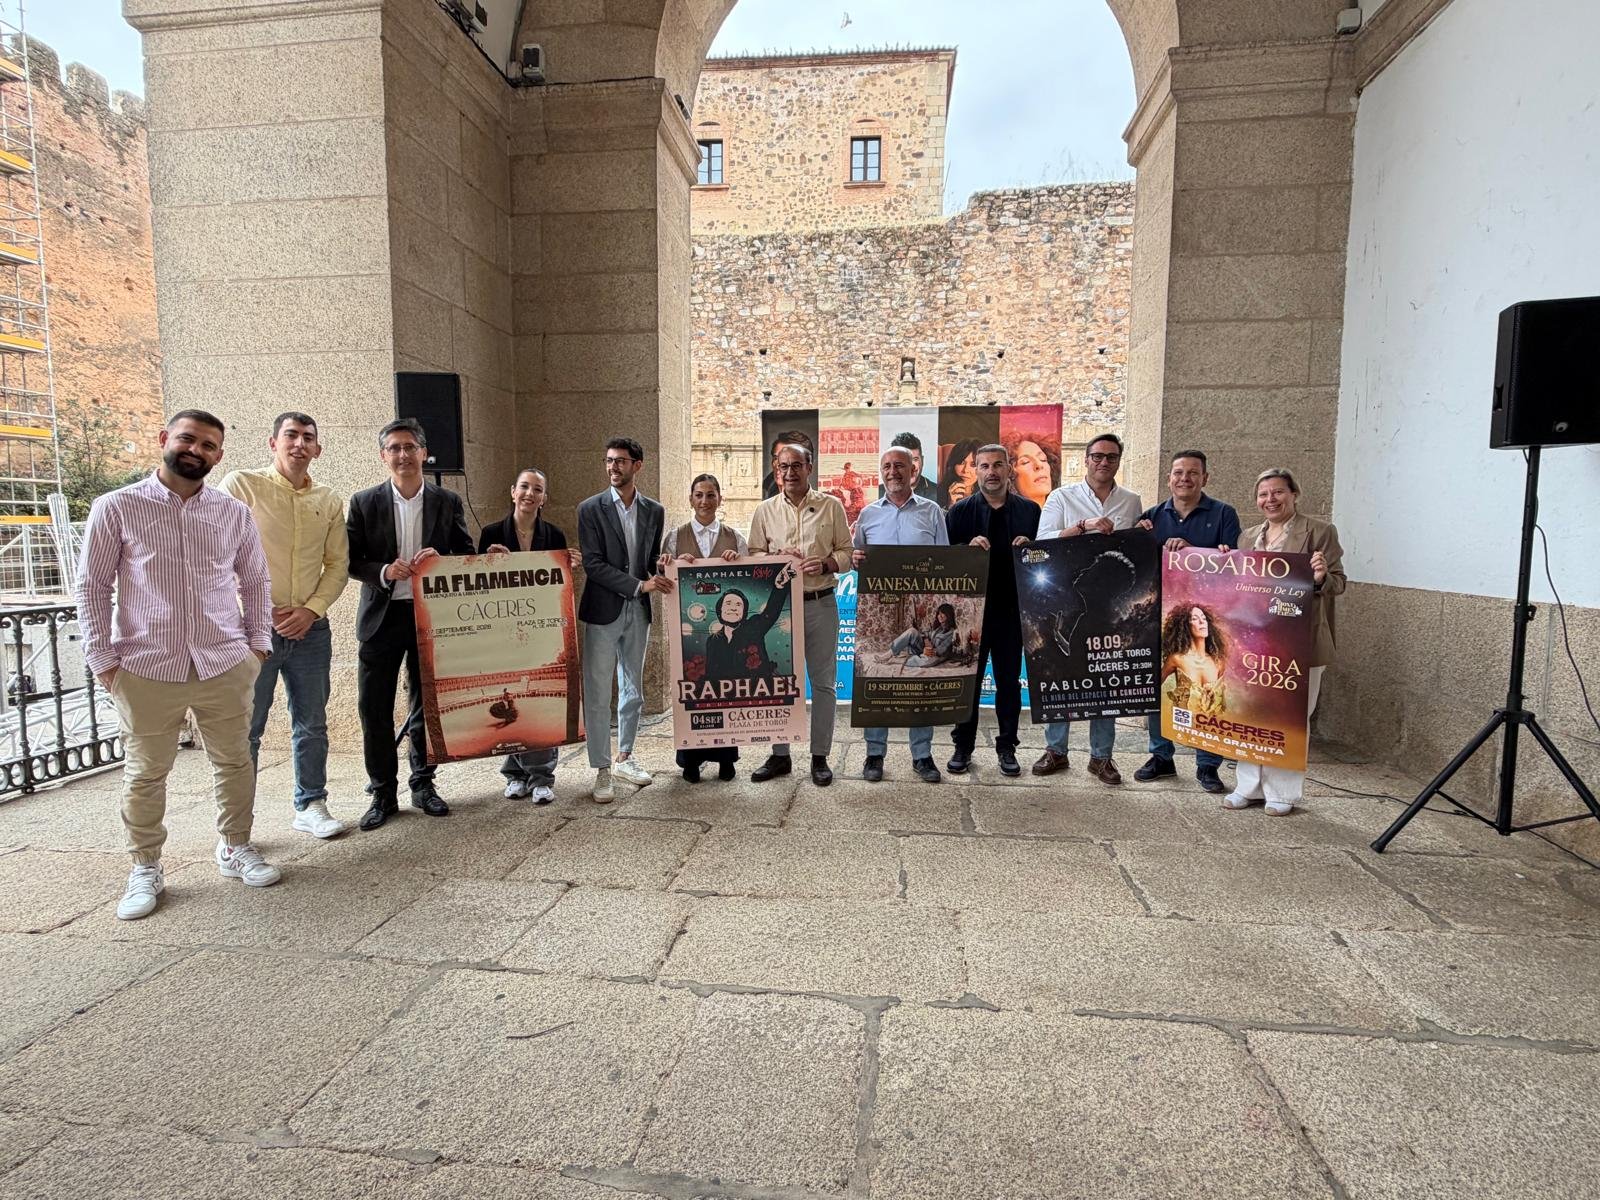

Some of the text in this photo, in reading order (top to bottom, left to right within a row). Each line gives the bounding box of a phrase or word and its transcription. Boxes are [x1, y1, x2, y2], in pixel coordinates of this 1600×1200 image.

[1168, 551, 1290, 579] ROSARIO
[422, 568, 564, 594] LA FLAMENCA
[696, 570, 751, 579] RAPHAEL
[866, 577, 920, 591] VANESA
[923, 573, 978, 591] MARTÍN
[1235, 582, 1305, 598] Universo De Ley
[457, 598, 536, 621] CÁCERES
[517, 619, 536, 627] PLAZA
[1086, 634, 1121, 650] 18.09
[1087, 648, 1151, 661] PLAZA DE TOROS
[1088, 661, 1130, 673] CÁCERES
[1242, 652, 1302, 676] GIRA
[680, 675, 797, 701] RAPHAEL
[868, 681, 961, 691] 19 SEPTIEMBRE CÁCERES
[1040, 674, 1154, 692] PABLO LÓPEZ
[1247, 669, 1298, 691] 2026
[1119, 687, 1155, 696] CONCIERTO
[728, 708, 791, 722] CÁCERES
[1174, 709, 1190, 718] 26
[1174, 716, 1190, 724] SEP
[1195, 724, 1233, 738] PLAZA
[1240, 735, 1286, 748] MAYOR
[1196, 714, 1285, 741] CÁCERES
[1173, 724, 1220, 742] ENTRADA
[1223, 737, 1285, 756] GRATUITA
